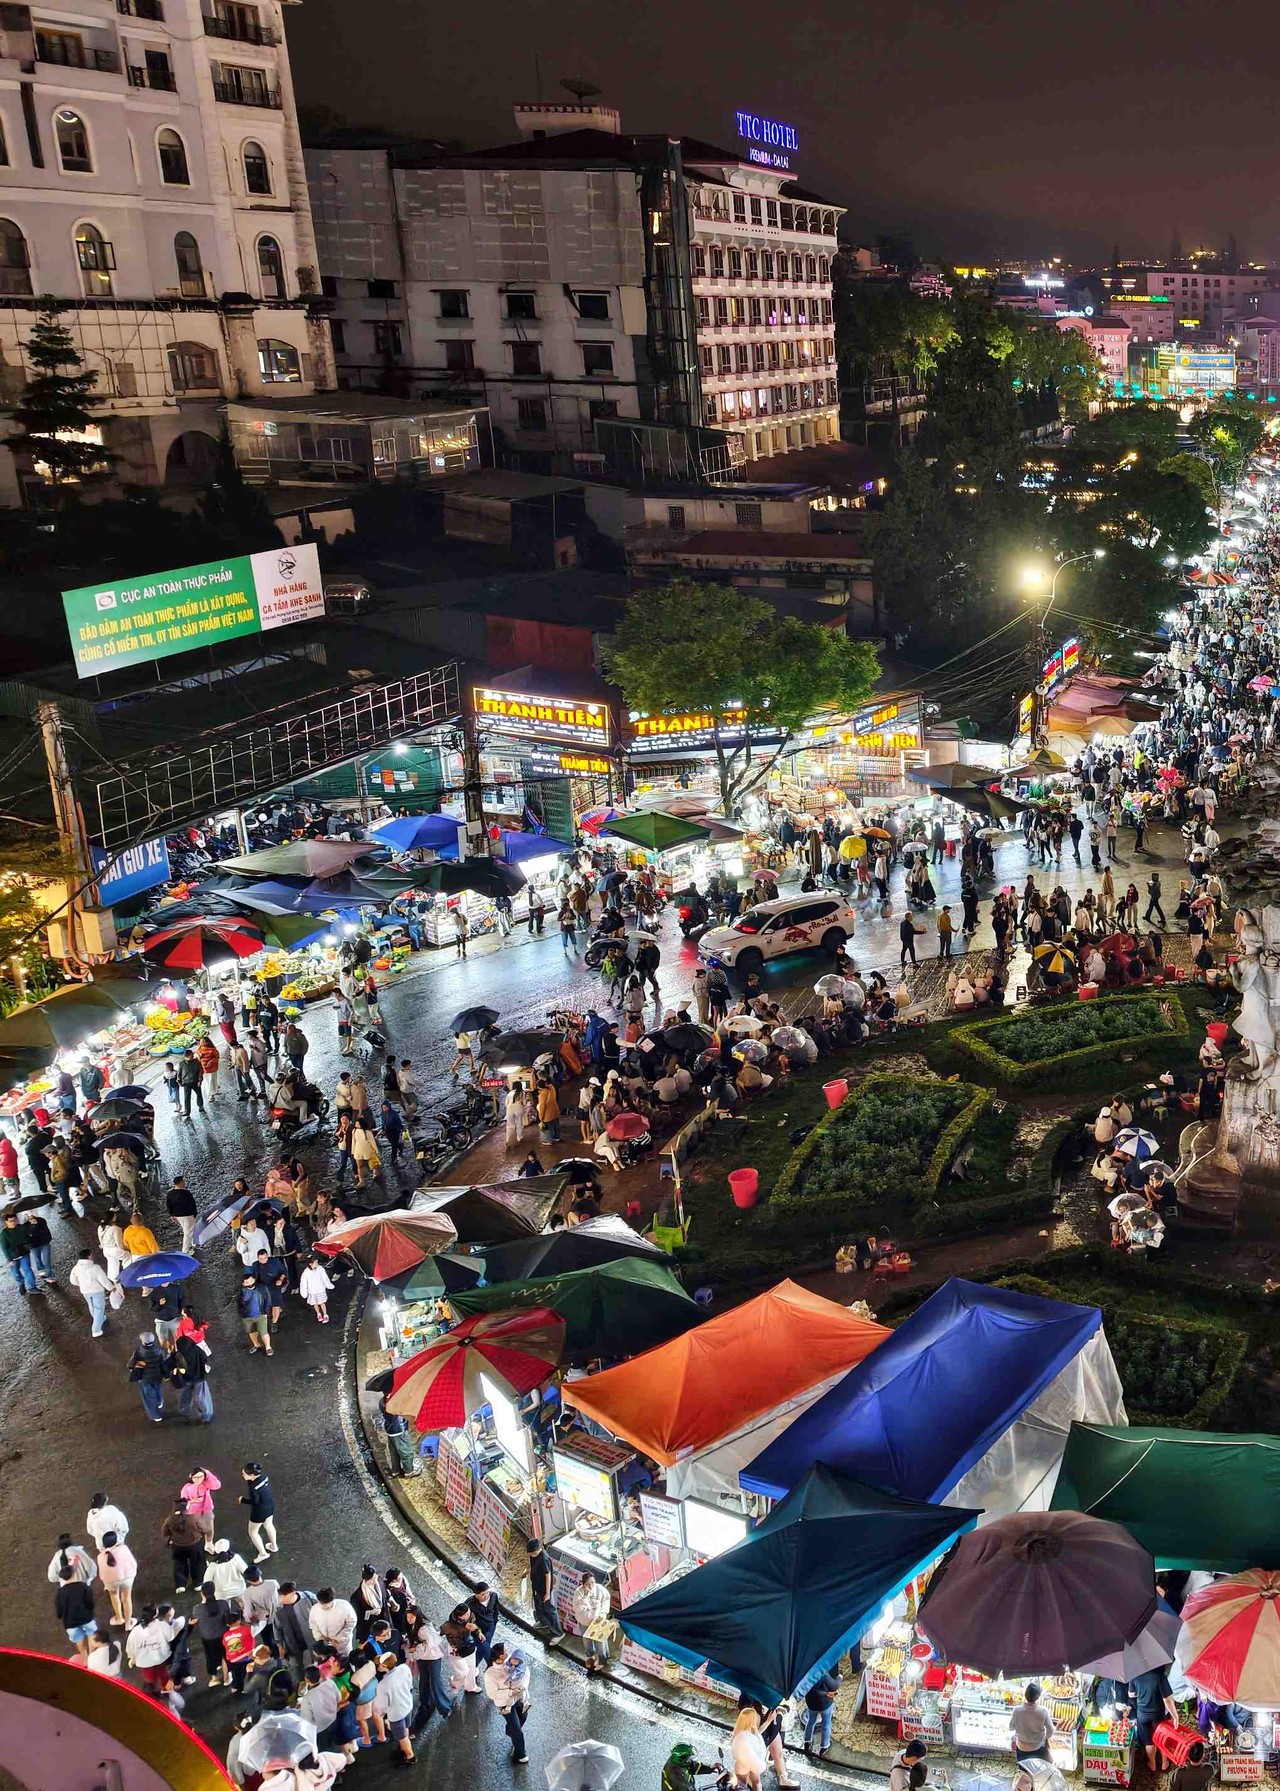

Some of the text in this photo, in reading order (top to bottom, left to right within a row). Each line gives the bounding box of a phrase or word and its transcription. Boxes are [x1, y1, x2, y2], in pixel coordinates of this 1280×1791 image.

[737, 112, 799, 151] TTC HOTEL
[121, 589, 141, 604] CỤC
[143, 586, 156, 598] AN
[158, 579, 182, 595] TOÀN
[145, 838, 162, 866] XE
